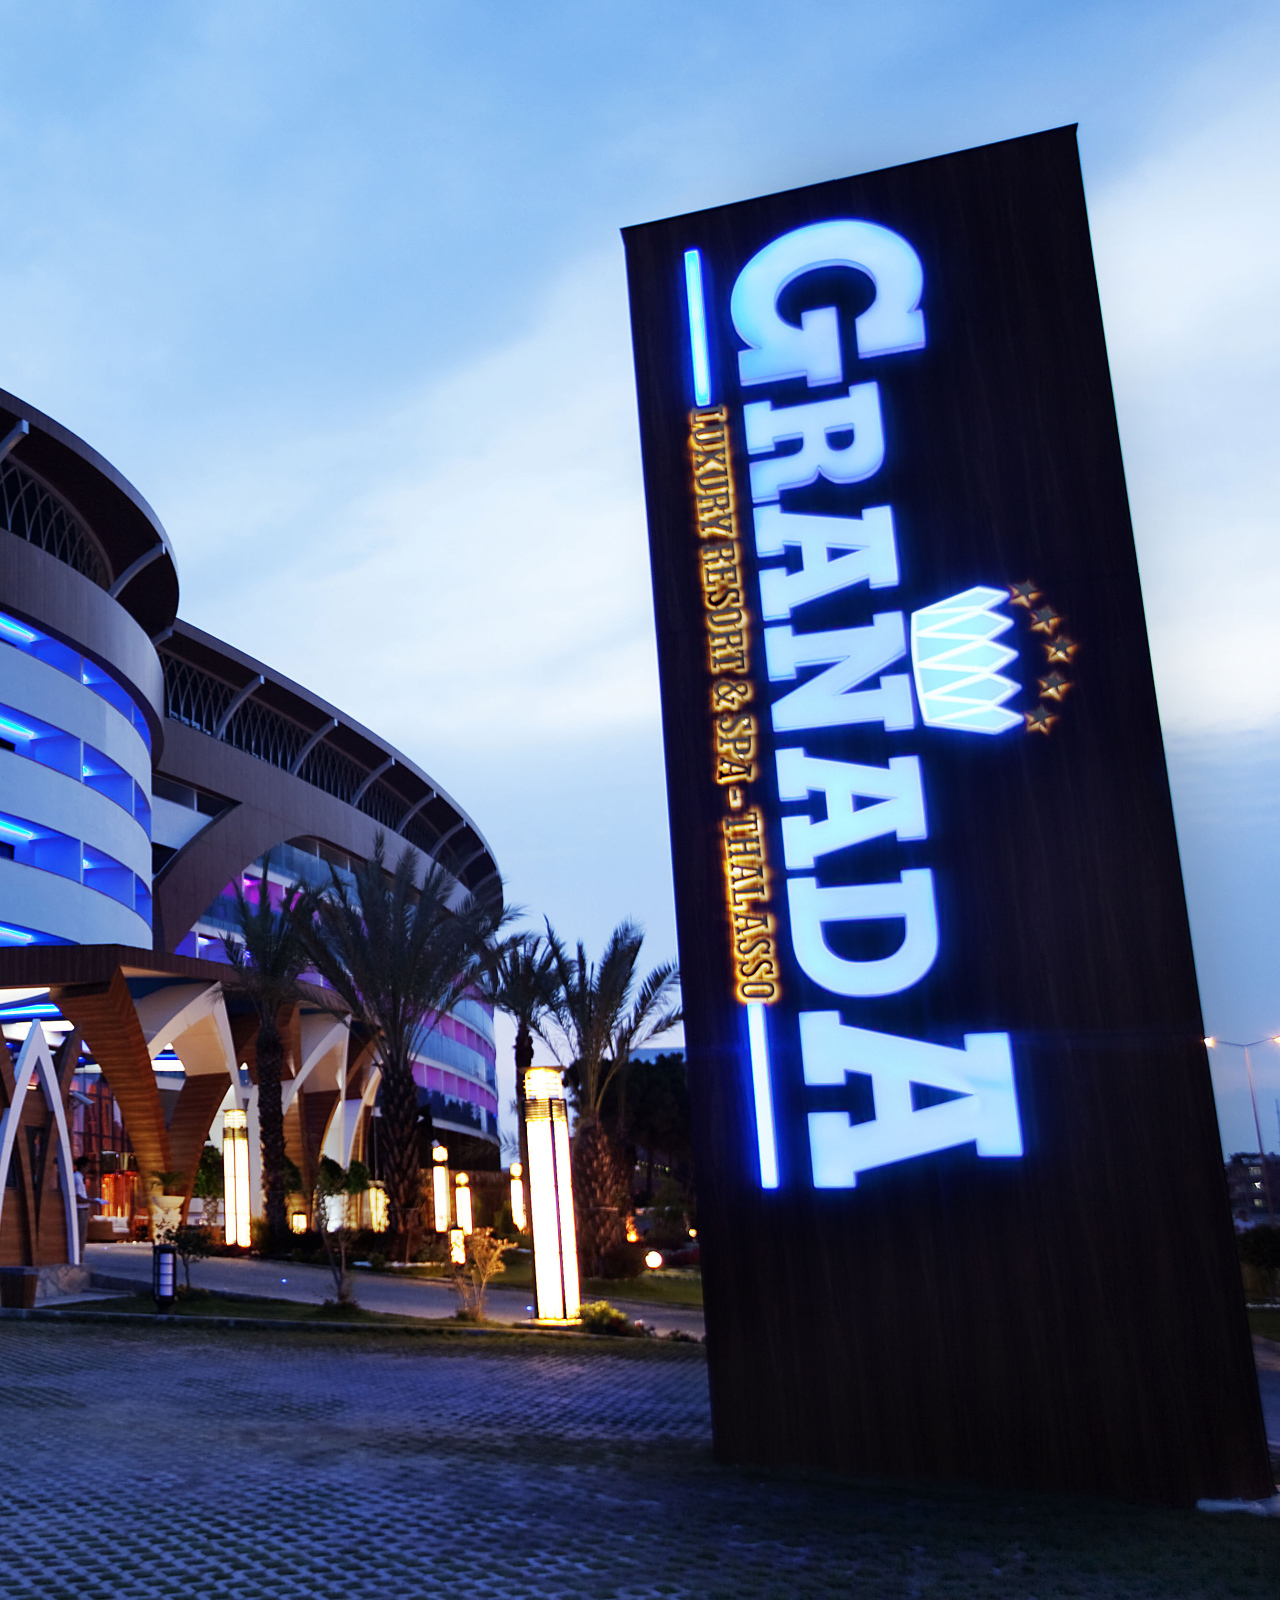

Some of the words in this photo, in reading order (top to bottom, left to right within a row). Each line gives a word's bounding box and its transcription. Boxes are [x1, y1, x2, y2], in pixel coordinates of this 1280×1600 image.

[690, 404, 734, 536] LUXURY
[701, 540, 748, 672] RESORT
[713, 680, 749, 708] &
[718, 714, 754, 783] SPA
[730, 218, 1023, 1189] GRANADA
[724, 811, 776, 1000] THALASSO
